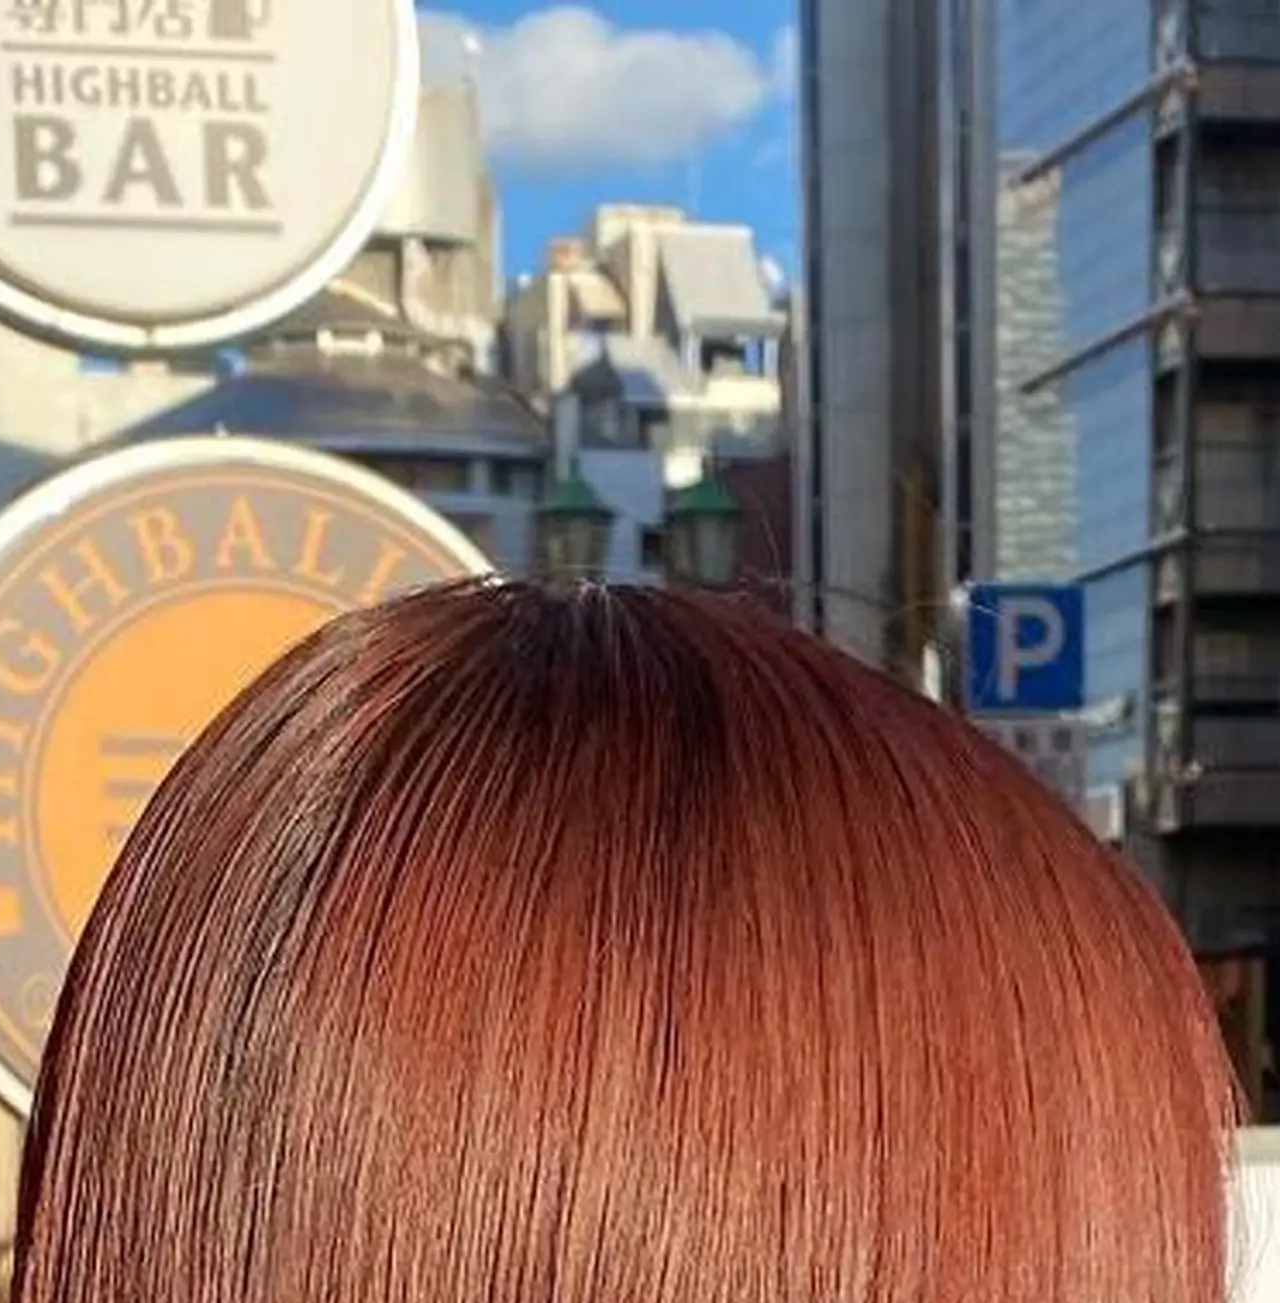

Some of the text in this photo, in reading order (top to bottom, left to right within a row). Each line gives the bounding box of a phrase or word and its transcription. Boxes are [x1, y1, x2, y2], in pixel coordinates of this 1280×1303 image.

[13, 63, 269, 112] HIGHBALL
[13, 113, 273, 210] BAR
[997, 596, 1065, 701] P
